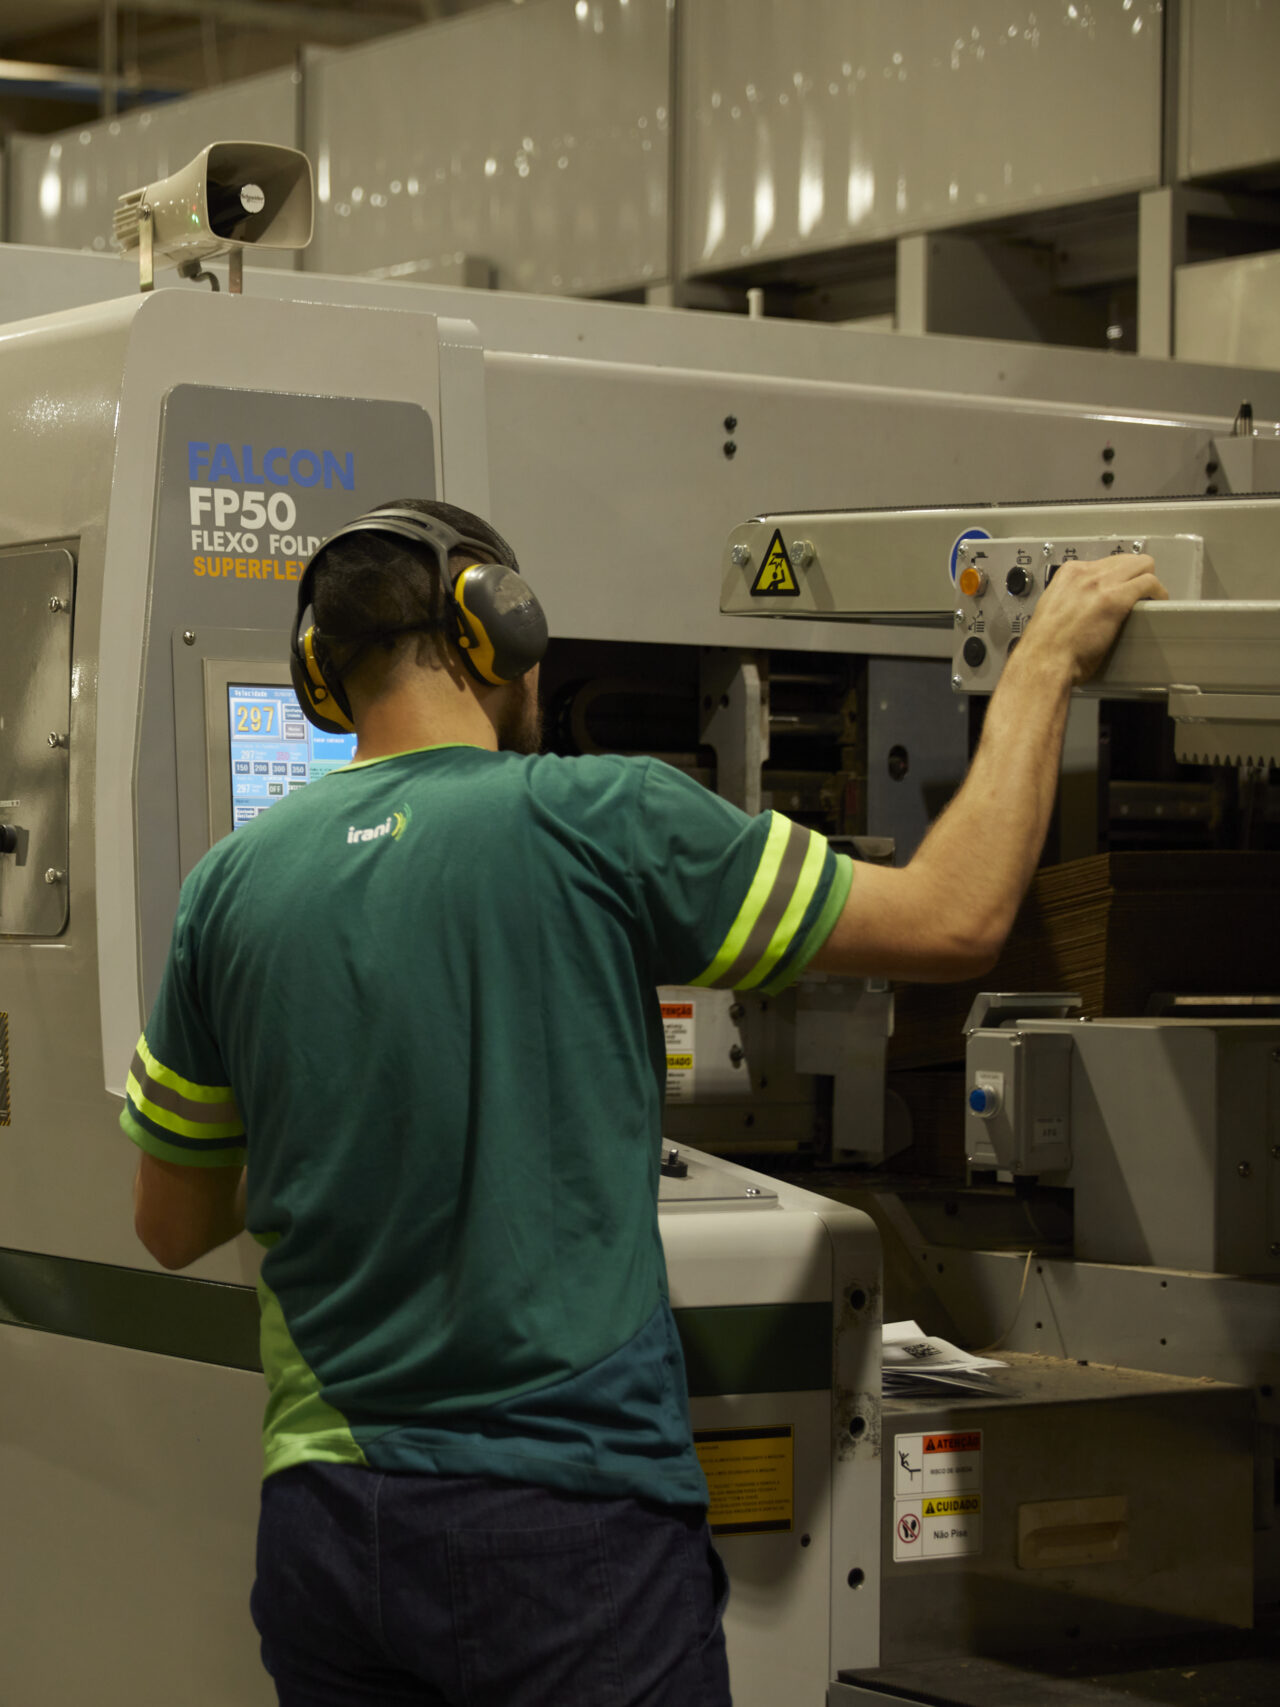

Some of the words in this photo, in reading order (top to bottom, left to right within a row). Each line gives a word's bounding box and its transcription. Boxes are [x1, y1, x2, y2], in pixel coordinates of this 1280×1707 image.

[188, 441, 355, 490] FALCON
[189, 486, 297, 531] FP50
[191, 530, 259, 553] FLEXO
[269, 534, 327, 557] FOLD
[237, 706, 274, 732] 297
[236, 763, 249, 771] 150
[255, 764, 268, 772] 200
[269, 785, 281, 793] OFF
[347, 816, 392, 844] irani
[661, 1005, 692, 1017] TENÇÃO
[937, 1434, 979, 1450] ATENÇÃO
[936, 1499, 978, 1513] CUIDADO
[933, 1529, 949, 1540] Não
[951, 1528, 969, 1538] Pise
